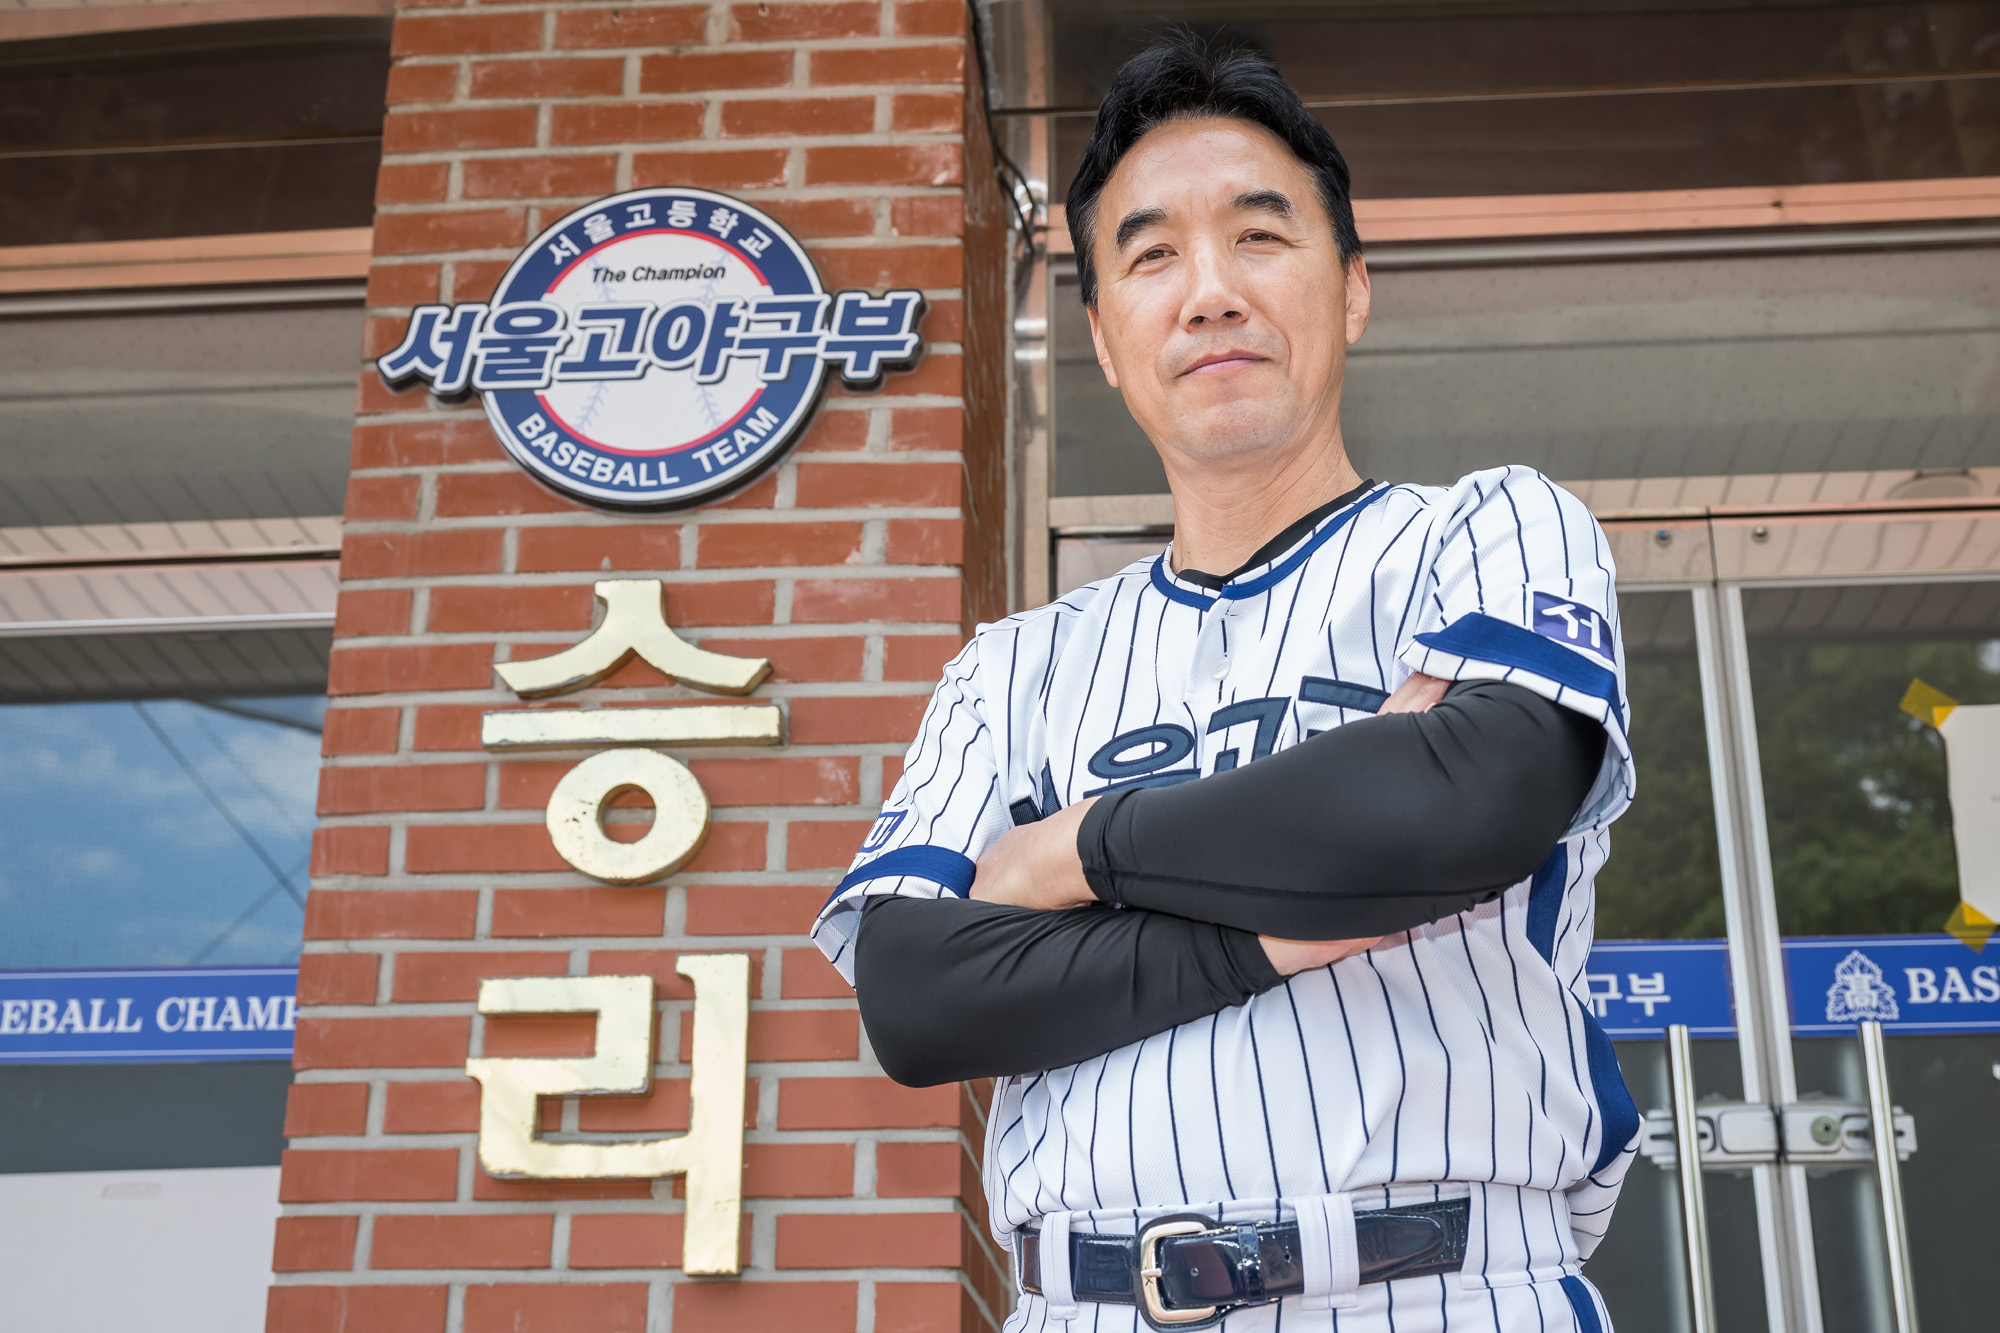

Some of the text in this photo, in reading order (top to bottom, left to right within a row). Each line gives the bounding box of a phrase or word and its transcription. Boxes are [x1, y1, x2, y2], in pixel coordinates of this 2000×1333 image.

[548, 199, 773, 266] 서울고등학교
[591, 263, 727, 284] The Champion
[377, 290, 923, 392] 서울고야구부
[516, 405, 781, 487] BASEBALL TEAM
[465, 578, 784, 1277] 승리
[1586, 971, 1672, 1018] 구부
[1903, 965, 2000, 1004] BAS
[0, 997, 143, 1036] EBALL
